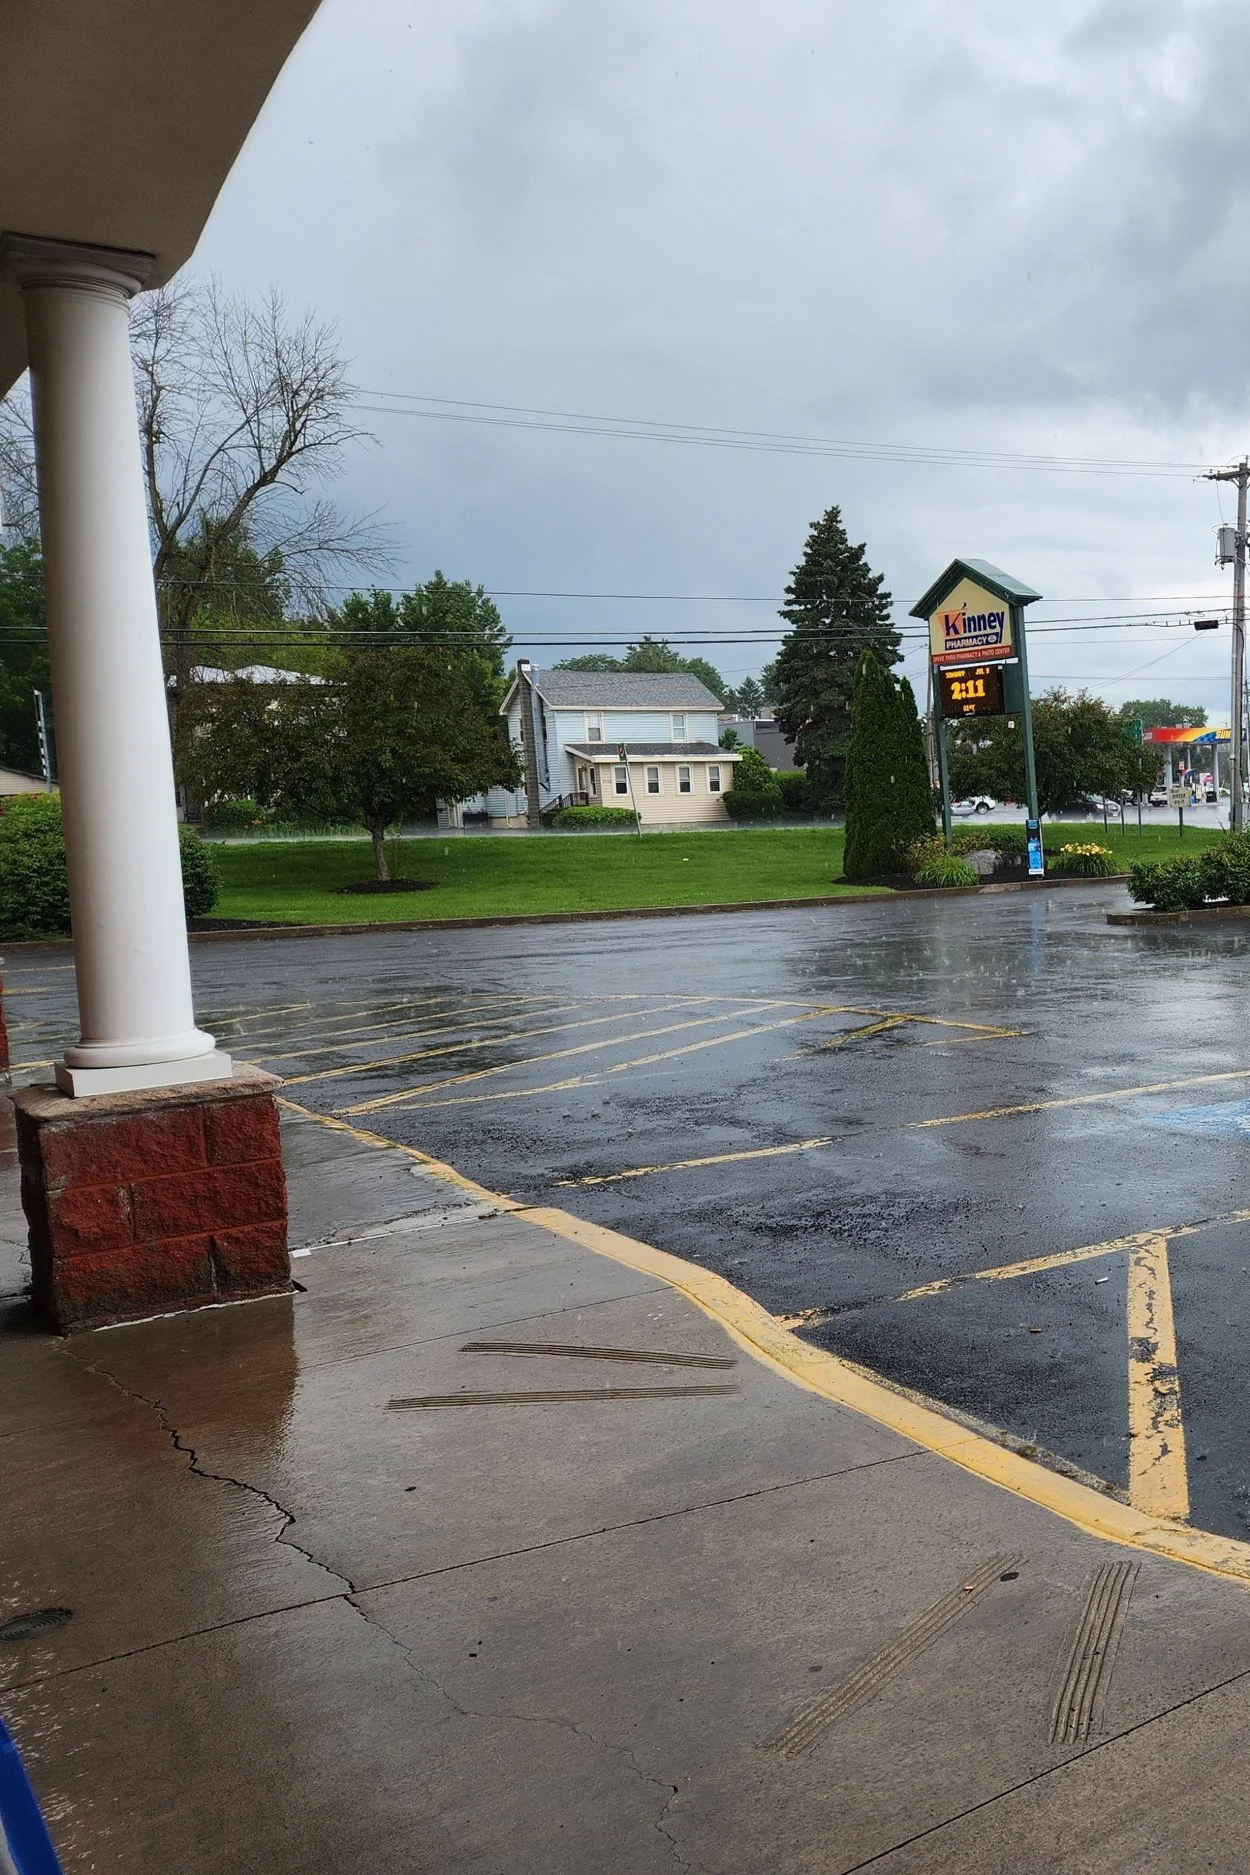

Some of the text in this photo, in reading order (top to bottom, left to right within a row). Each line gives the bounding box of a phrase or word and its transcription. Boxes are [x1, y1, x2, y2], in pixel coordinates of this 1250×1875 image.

[944, 602, 1005, 644] Kinney
[946, 635, 987, 649] PHARMACY
[932, 655, 945, 663] DRIVE
[945, 653, 956, 661] THRU
[956, 651, 978, 660] PHARMACY
[981, 648, 995, 657] PHOTO
[995, 646, 1011, 655] CENTER
[945, 670, 966, 679] SUNDAY
[951, 679, 986, 700] 2:11
[1216, 730, 1232, 739] SUN
